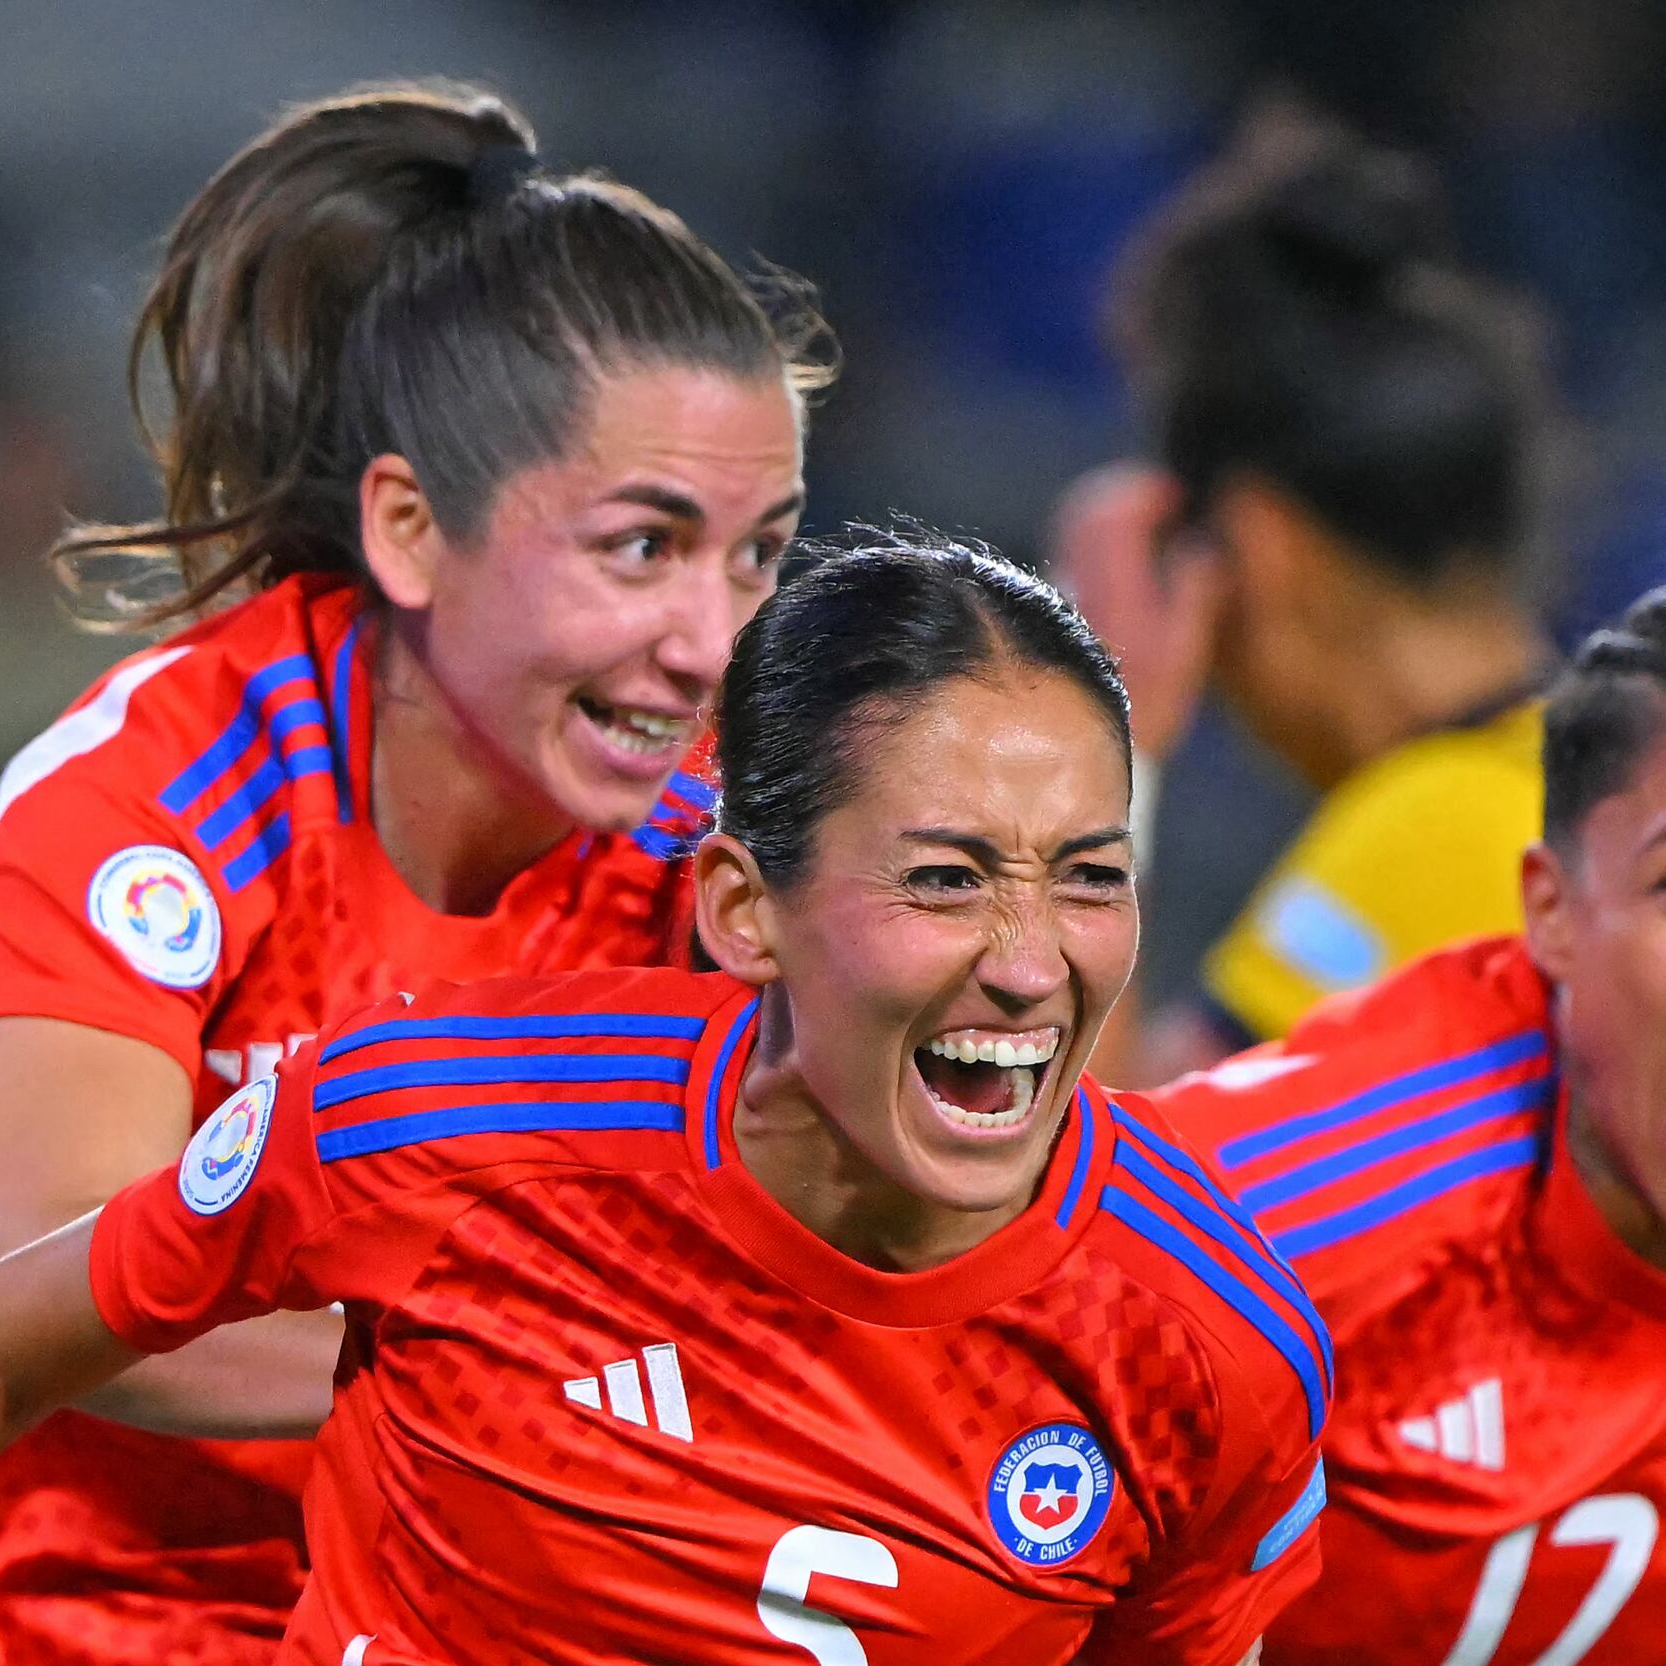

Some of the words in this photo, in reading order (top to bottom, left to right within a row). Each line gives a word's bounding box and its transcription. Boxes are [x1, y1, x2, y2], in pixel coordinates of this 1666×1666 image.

[220, 1156, 254, 1203] FEMENINA
[993, 1430, 1060, 1492] FEDERACION
[1068, 1432, 1086, 1449] DE
[1085, 1446, 1109, 1497] FUTBOL
[1016, 1537, 1034, 1557] DE
[1040, 1538, 1075, 1560] CHILE
